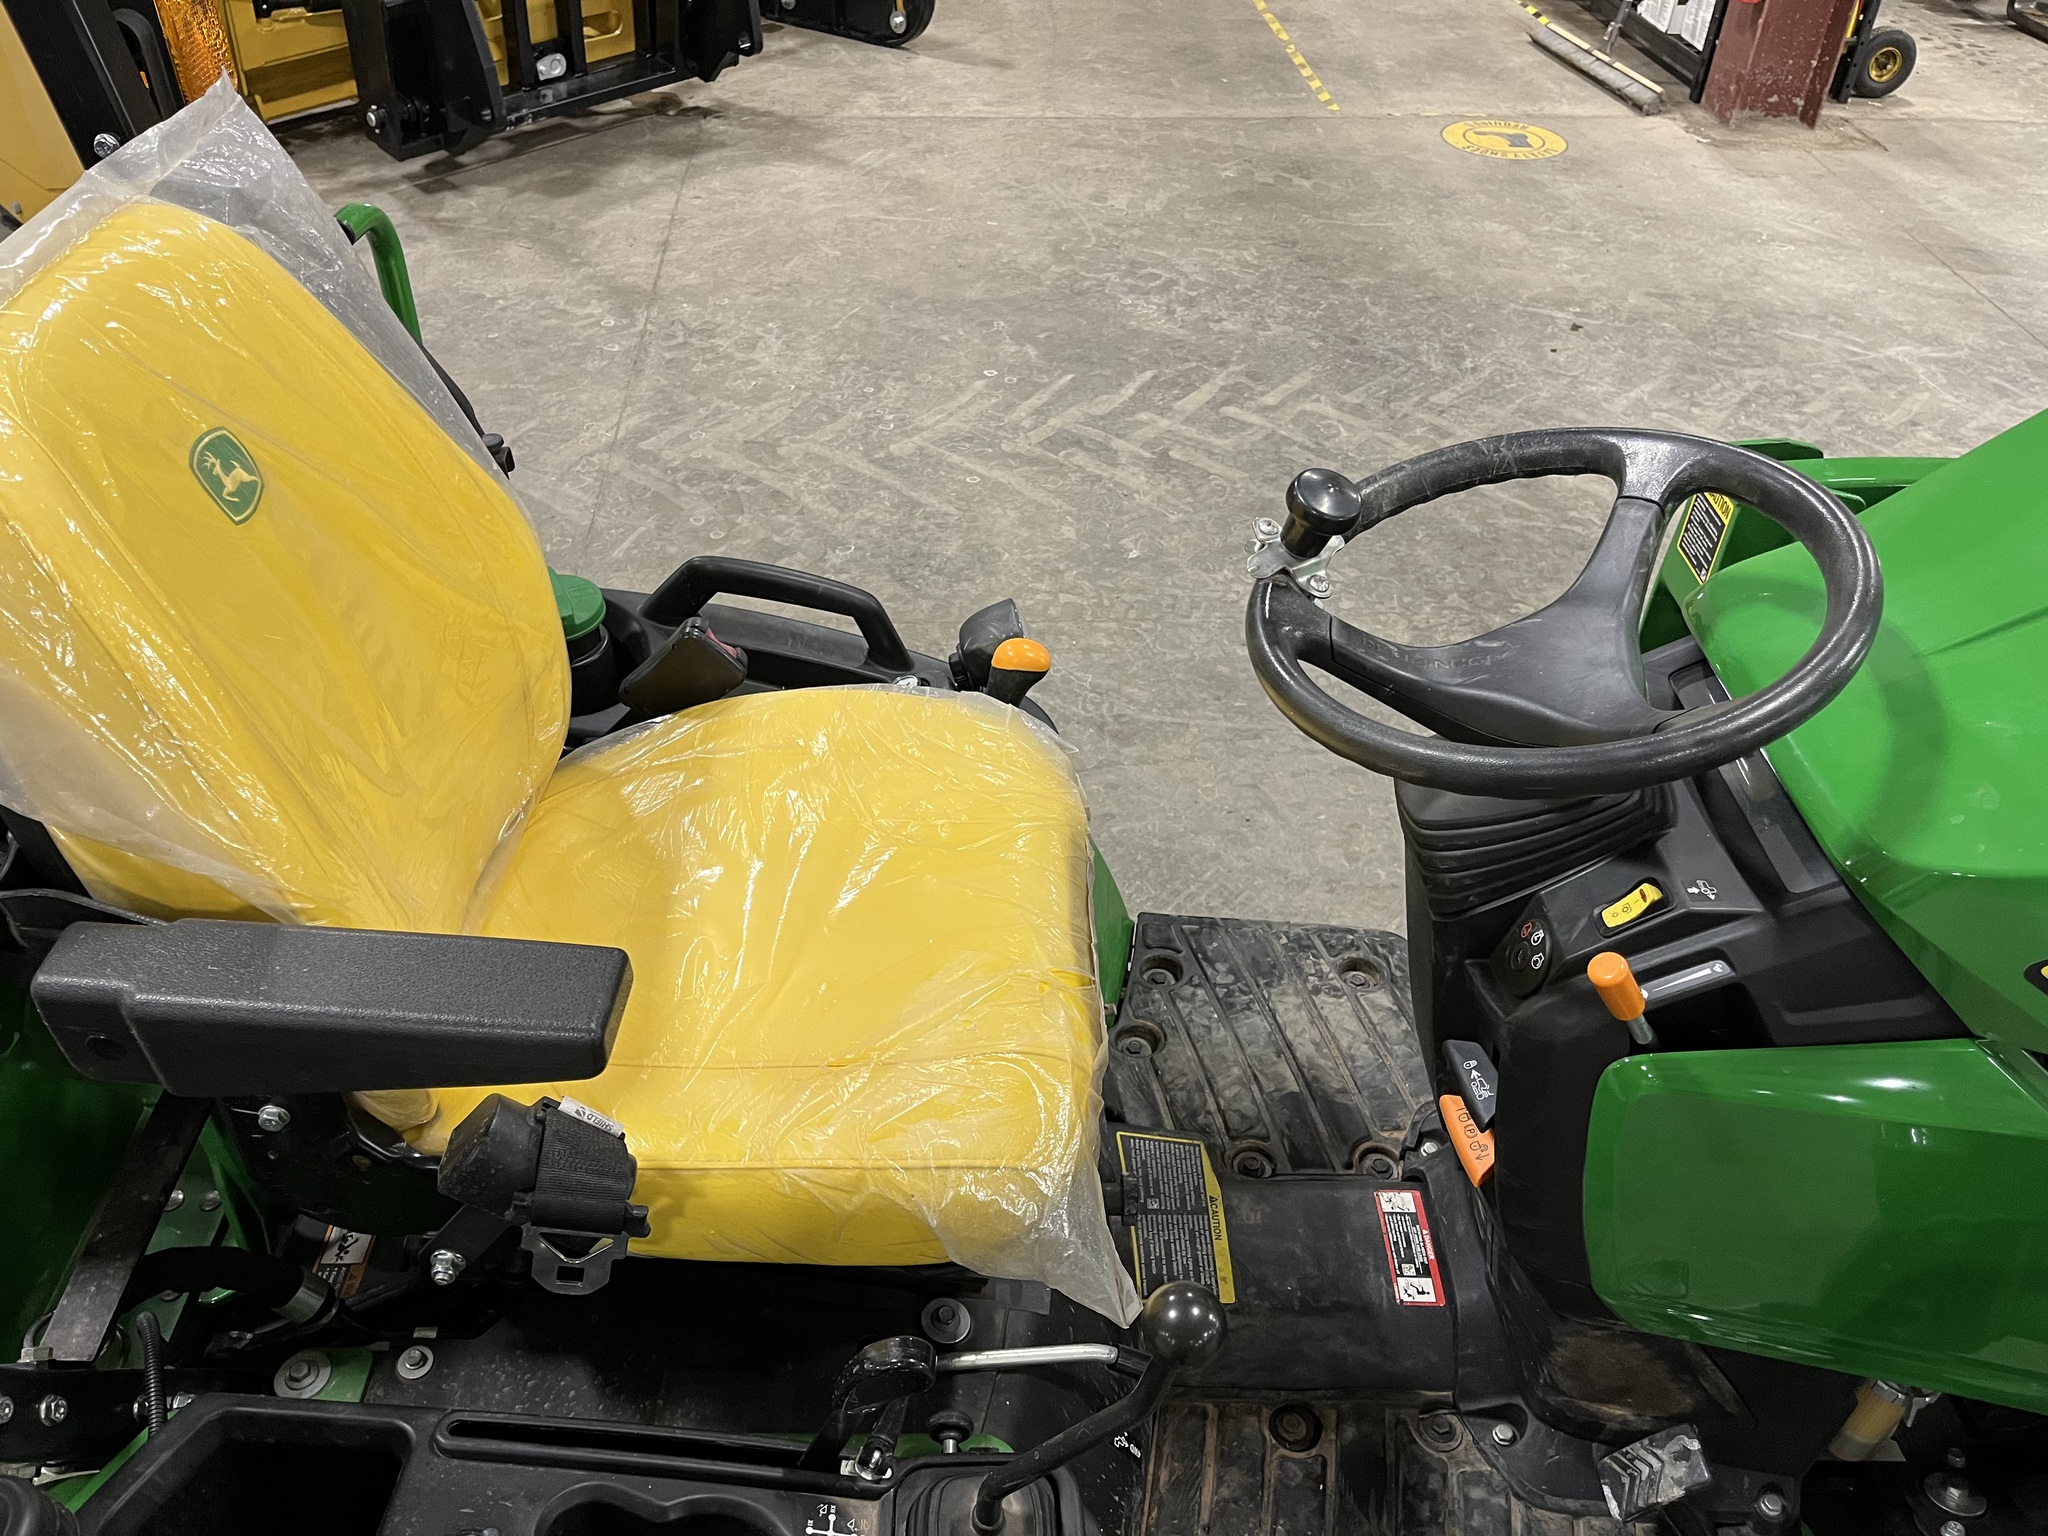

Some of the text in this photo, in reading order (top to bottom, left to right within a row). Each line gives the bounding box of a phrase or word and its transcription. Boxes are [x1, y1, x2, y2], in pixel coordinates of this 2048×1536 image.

[586, 1113, 615, 1132] SHIELD
[1209, 1202, 1222, 1241] CAUTION
[1423, 1235, 1435, 1260] DANGER
